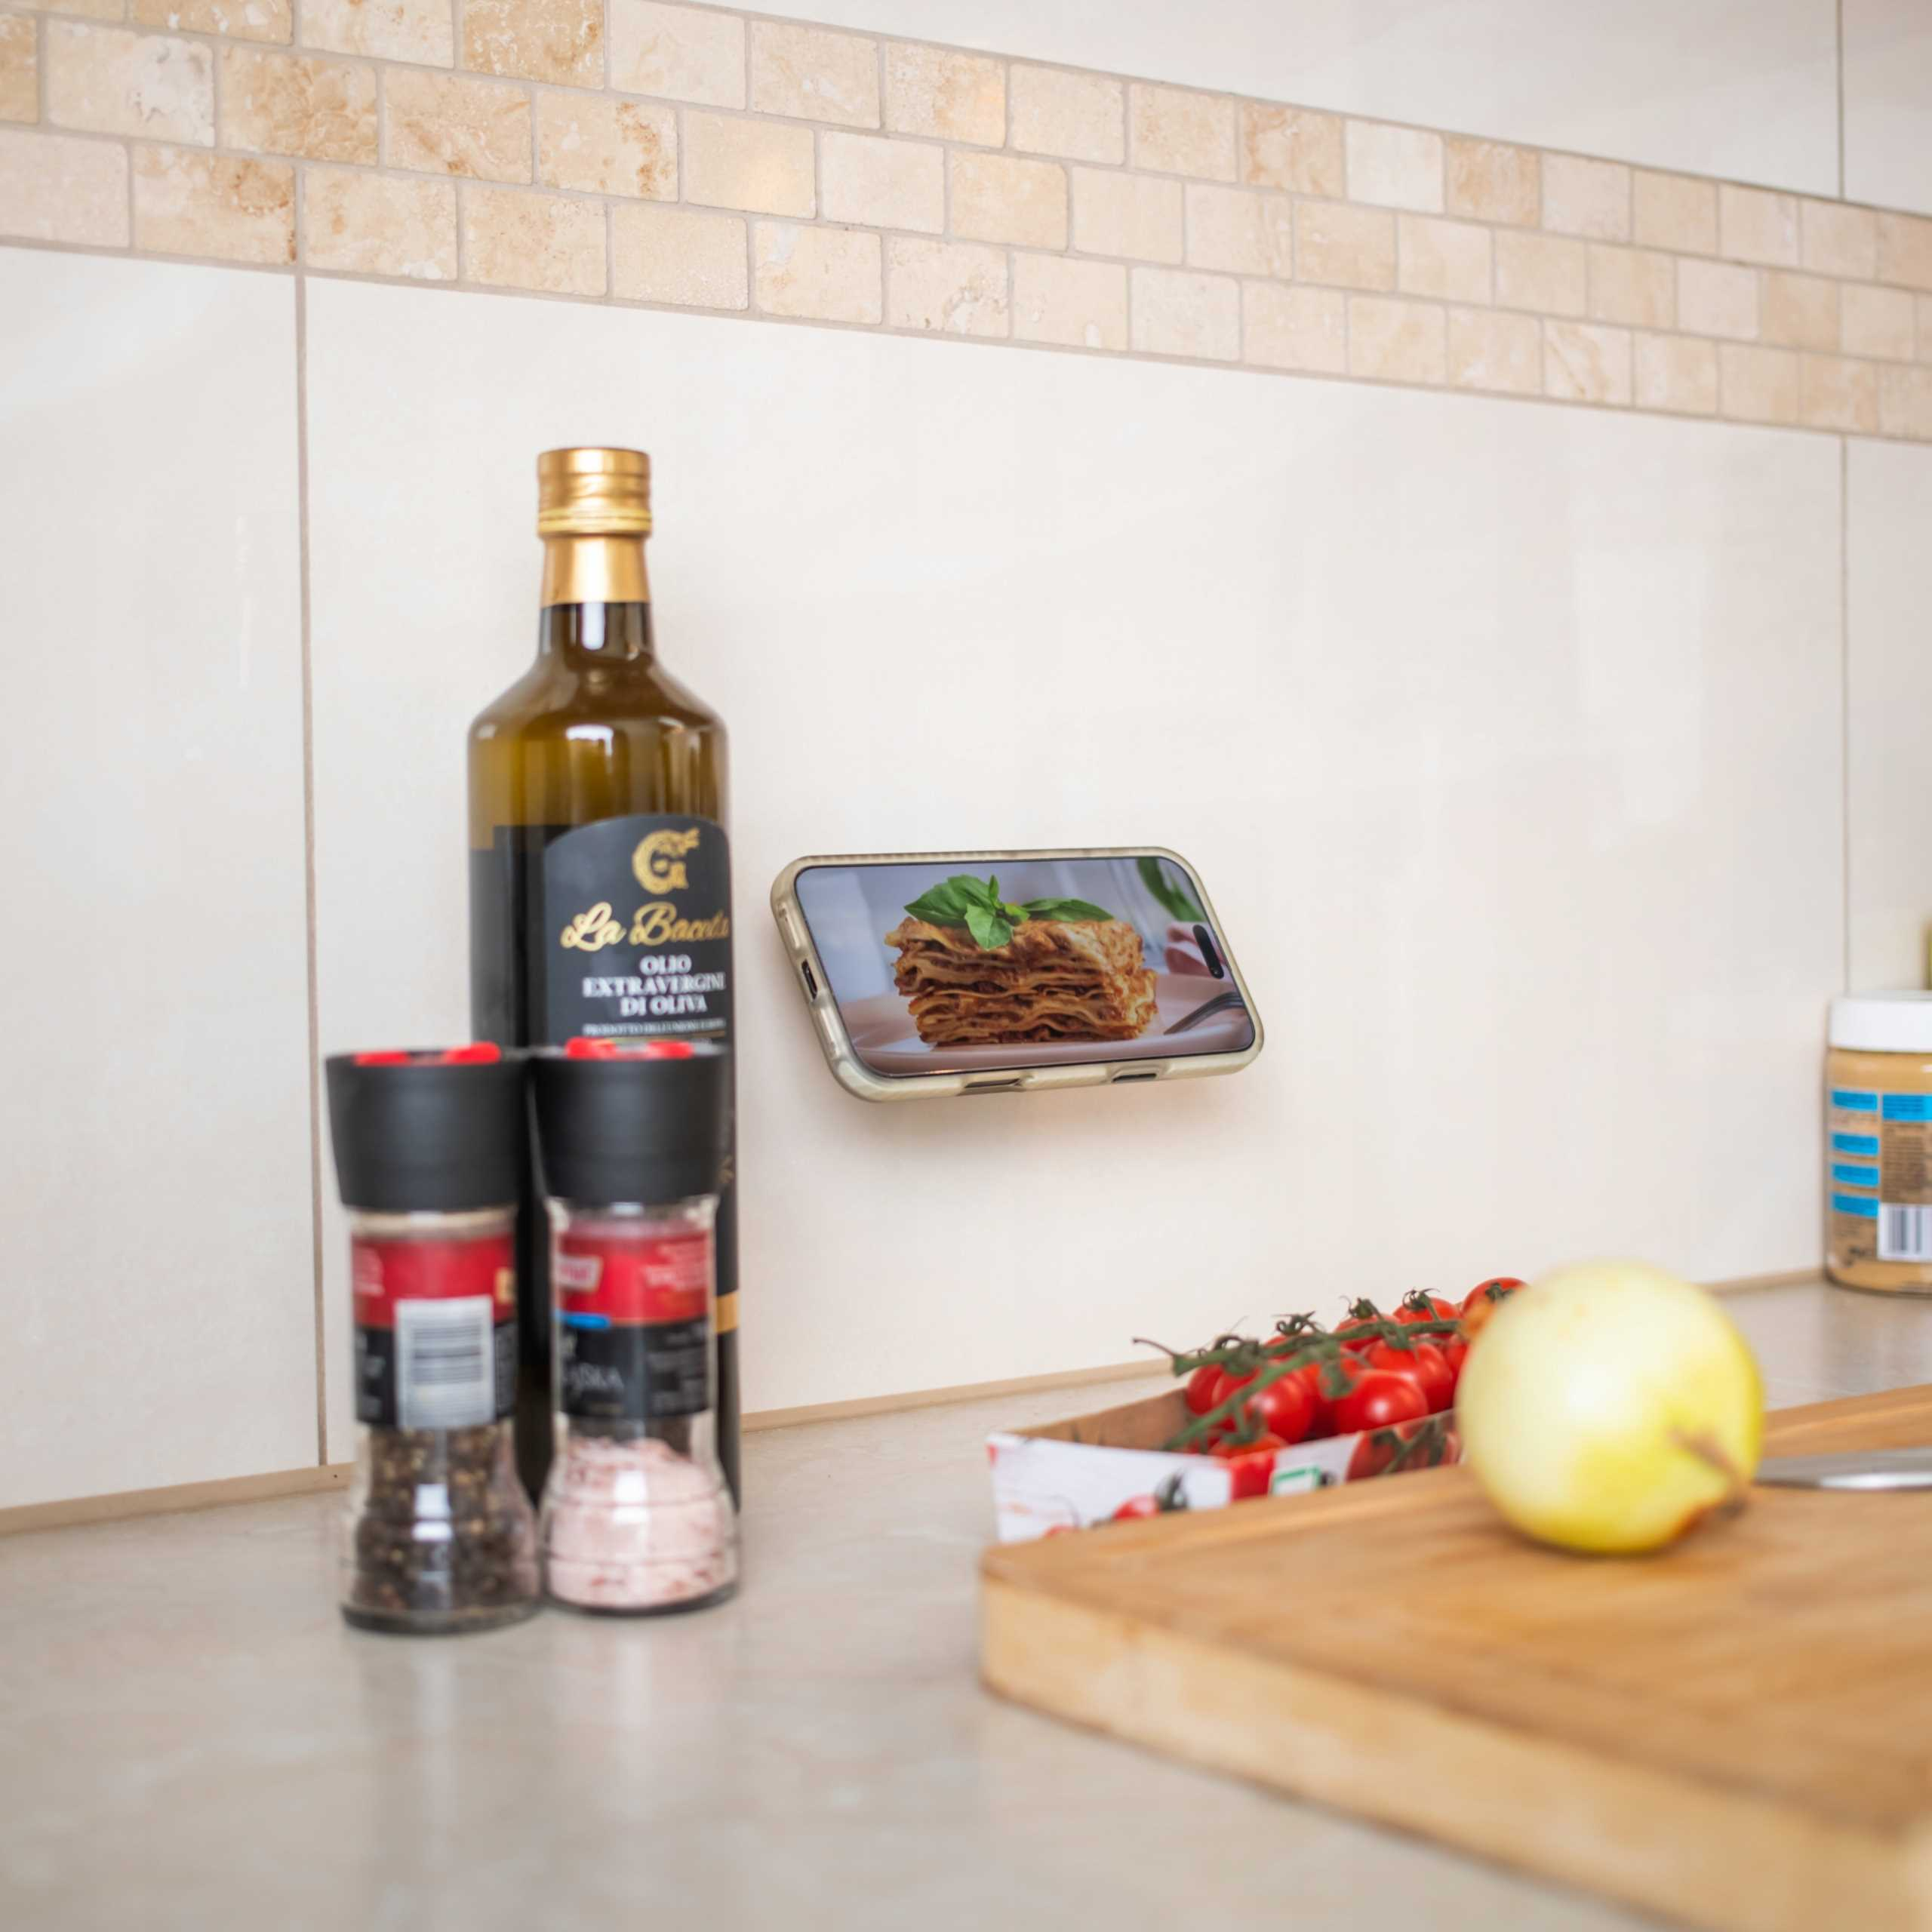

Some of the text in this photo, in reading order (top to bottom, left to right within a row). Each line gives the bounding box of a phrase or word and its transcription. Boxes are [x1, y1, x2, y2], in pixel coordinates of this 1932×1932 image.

[560, 901, 627, 952] La
[639, 954, 691, 976] OLIO
[620, 994, 708, 1017] DI OLIVA
